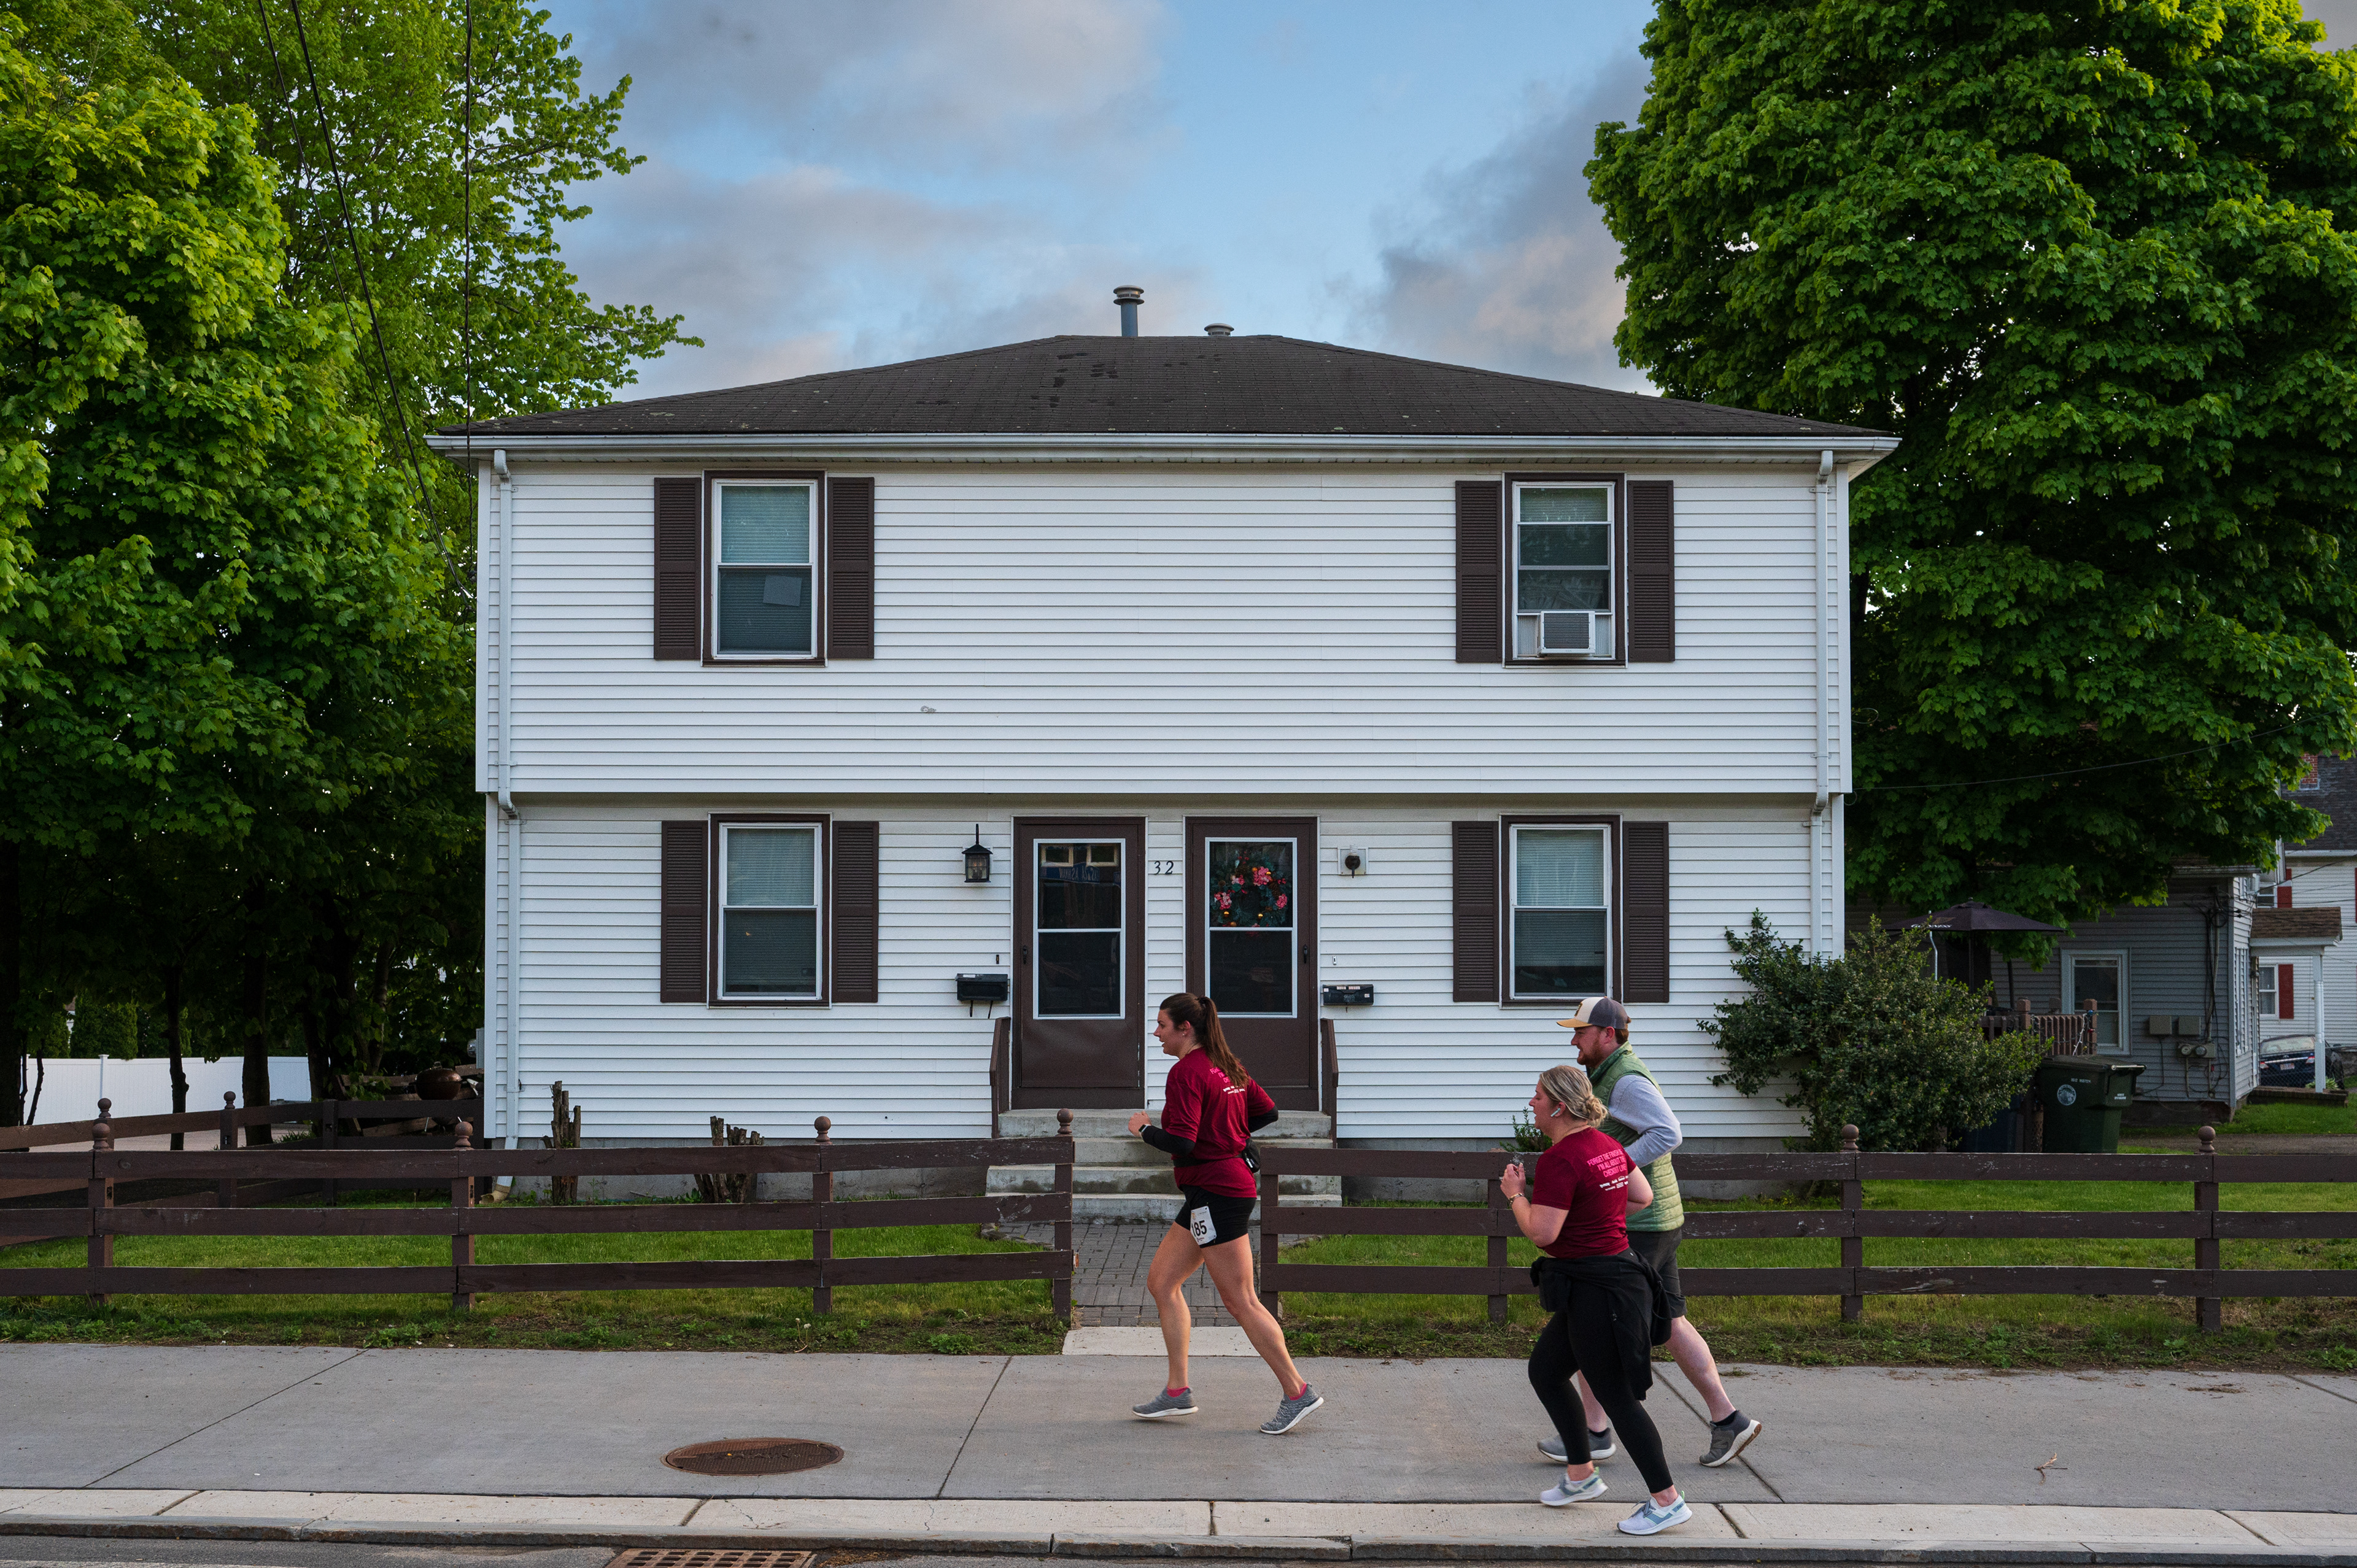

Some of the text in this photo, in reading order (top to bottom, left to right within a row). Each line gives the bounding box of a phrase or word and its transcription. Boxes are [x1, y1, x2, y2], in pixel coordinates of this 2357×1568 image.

[1154, 860, 1174, 875] 32
[1587, 1155, 1604, 1167] FORGET
[1191, 1220, 1207, 1237] 185
